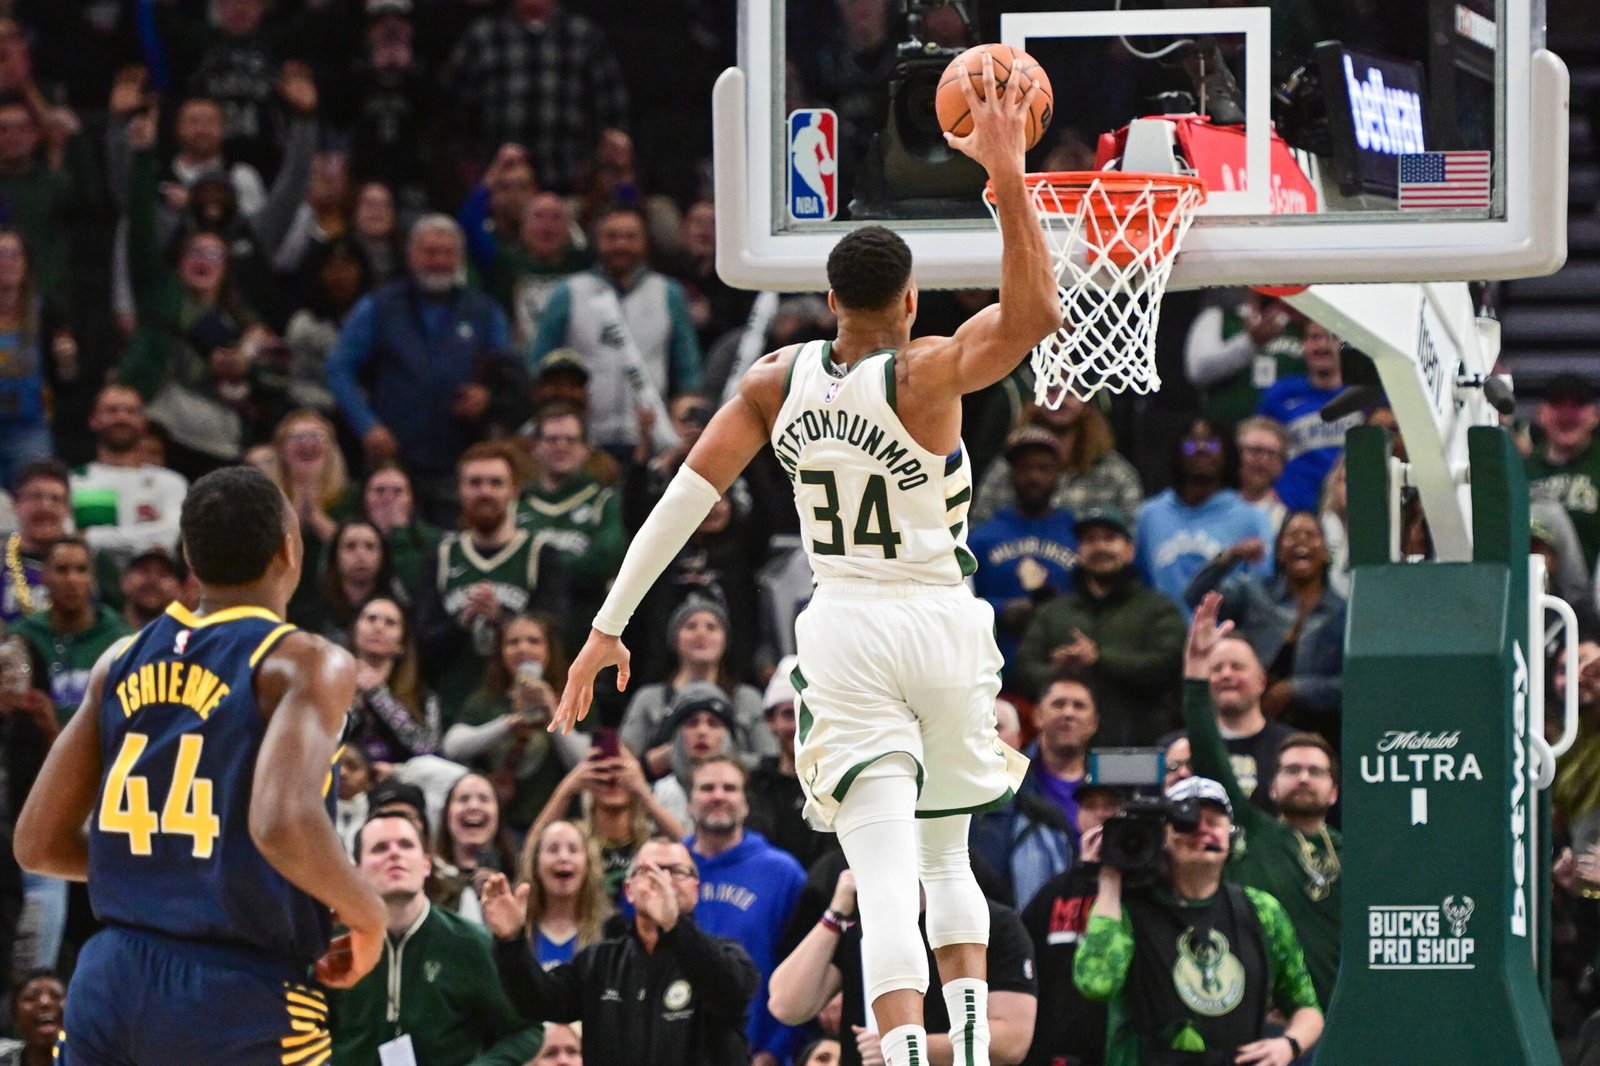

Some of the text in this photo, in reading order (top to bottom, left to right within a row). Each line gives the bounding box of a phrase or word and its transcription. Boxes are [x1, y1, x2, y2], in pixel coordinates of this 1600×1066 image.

[795, 195, 820, 214] NBA
[799, 469, 902, 560] 34
[1376, 729, 1463, 753] Michelob
[1360, 753, 1484, 783] ULTRA
[98, 731, 221, 860] 44
[1511, 638, 1529, 938] betway
[1368, 911, 1440, 937] BUCKS
[1368, 937, 1475, 964] PRO SHOP
